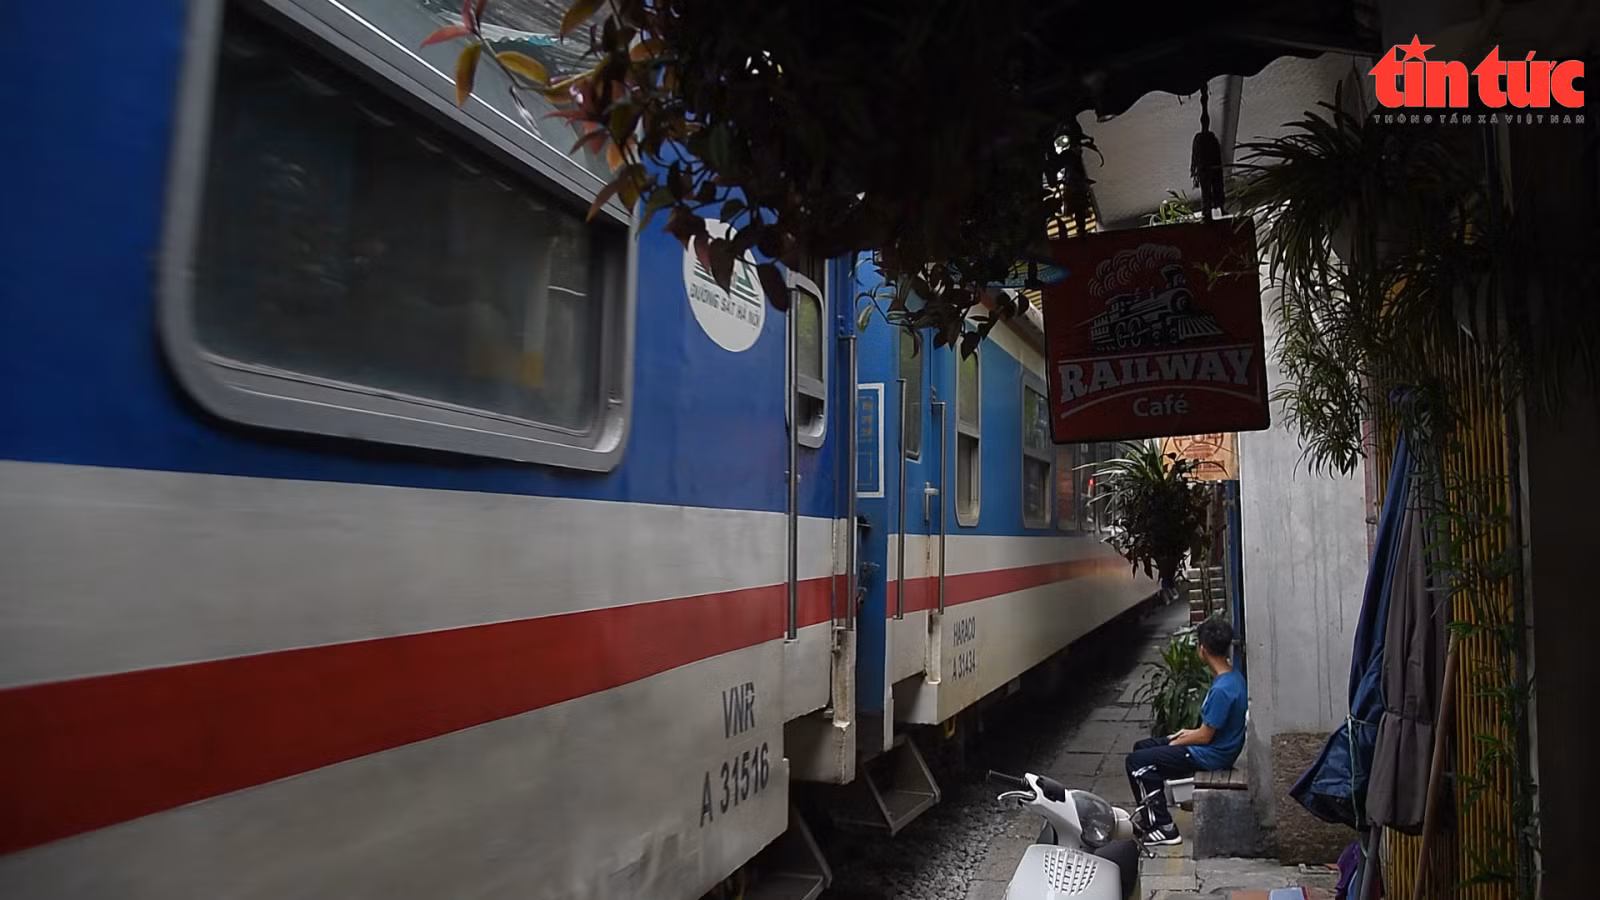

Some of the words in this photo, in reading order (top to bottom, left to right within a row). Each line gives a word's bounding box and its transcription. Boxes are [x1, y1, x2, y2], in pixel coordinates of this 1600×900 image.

[1058, 350, 1254, 404] RAILWAY
[1132, 393, 1189, 417] Café
[952, 656, 957, 682] A
[722, 682, 756, 739] VNR
[699, 771, 714, 828] A
[720, 742, 769, 815] 31516
